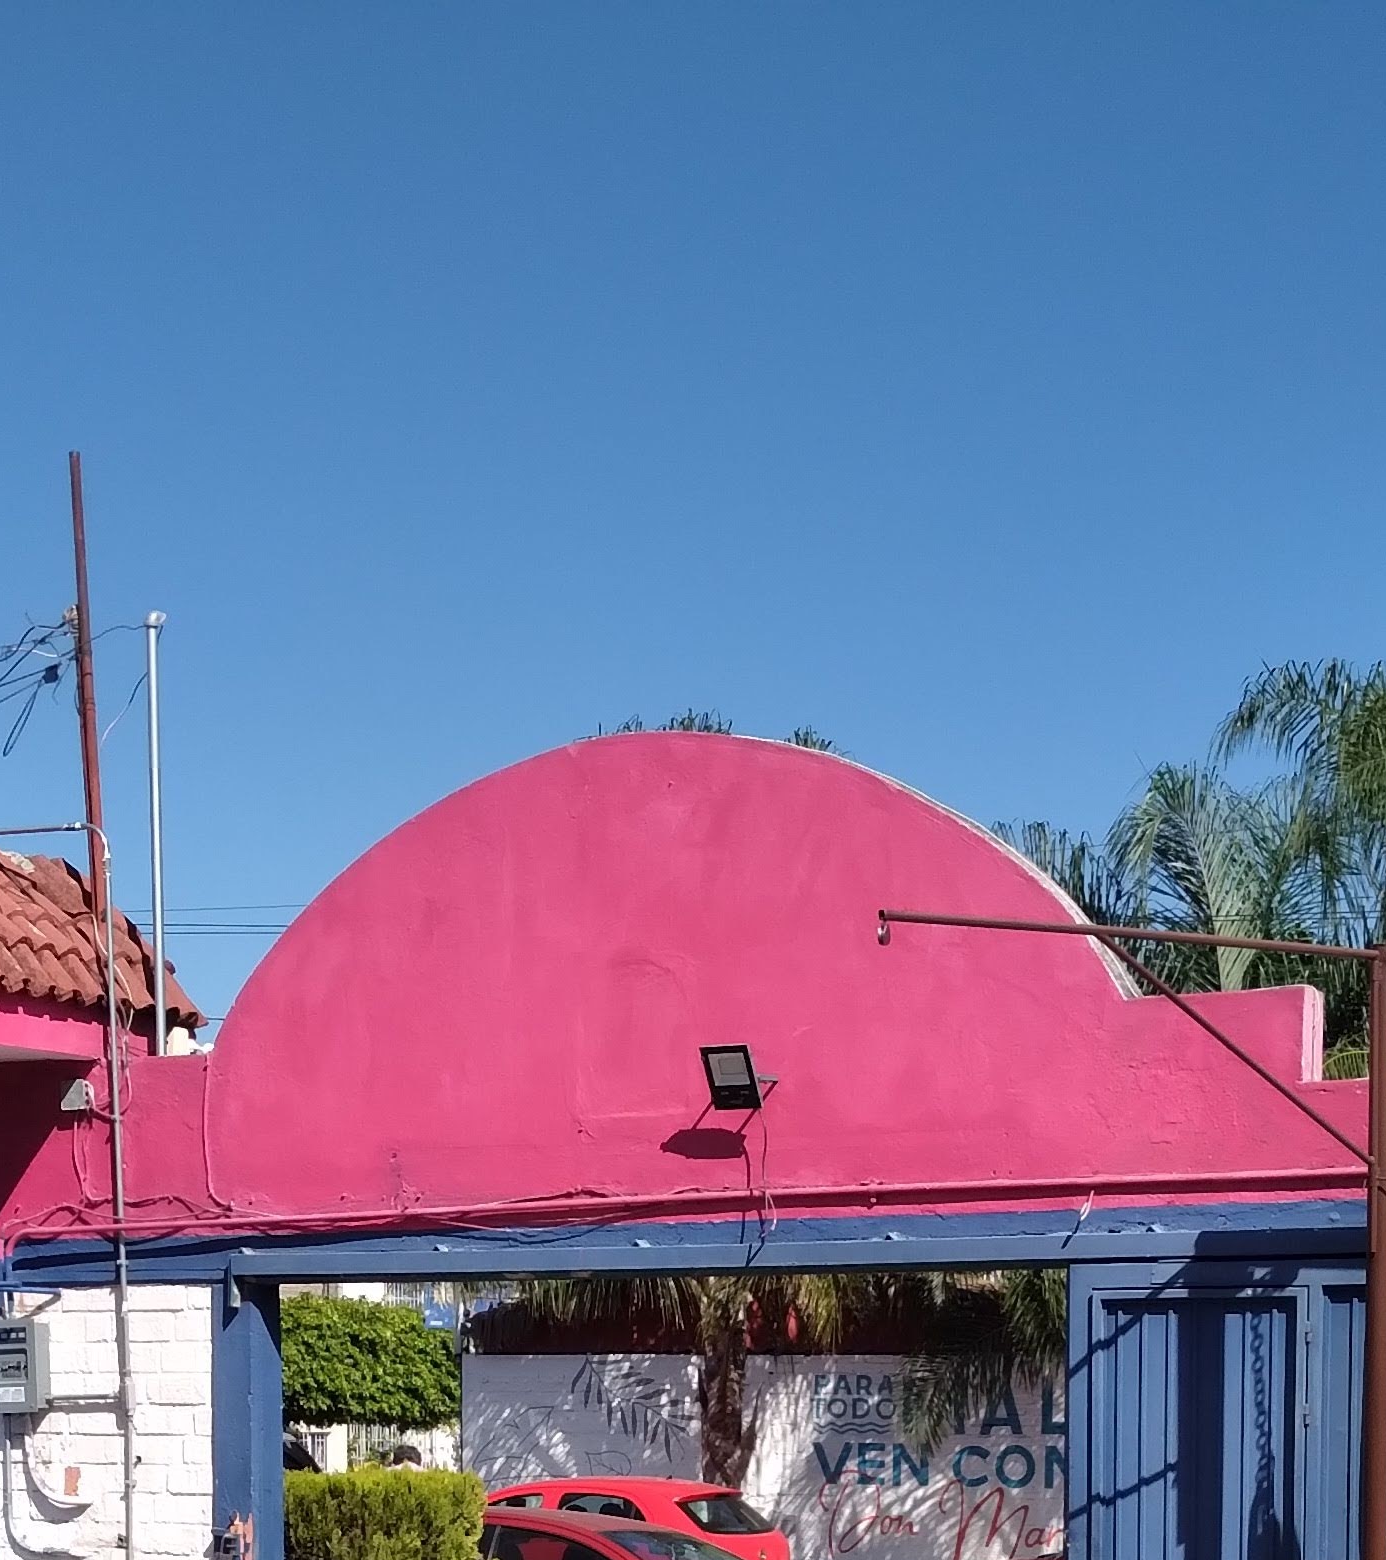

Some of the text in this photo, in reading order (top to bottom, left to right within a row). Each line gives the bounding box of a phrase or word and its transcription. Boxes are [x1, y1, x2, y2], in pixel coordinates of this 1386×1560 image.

[814, 1374, 893, 1396] PARA
[813, 1442, 930, 1487] VEN
[819, 1469, 918, 1560] Don
